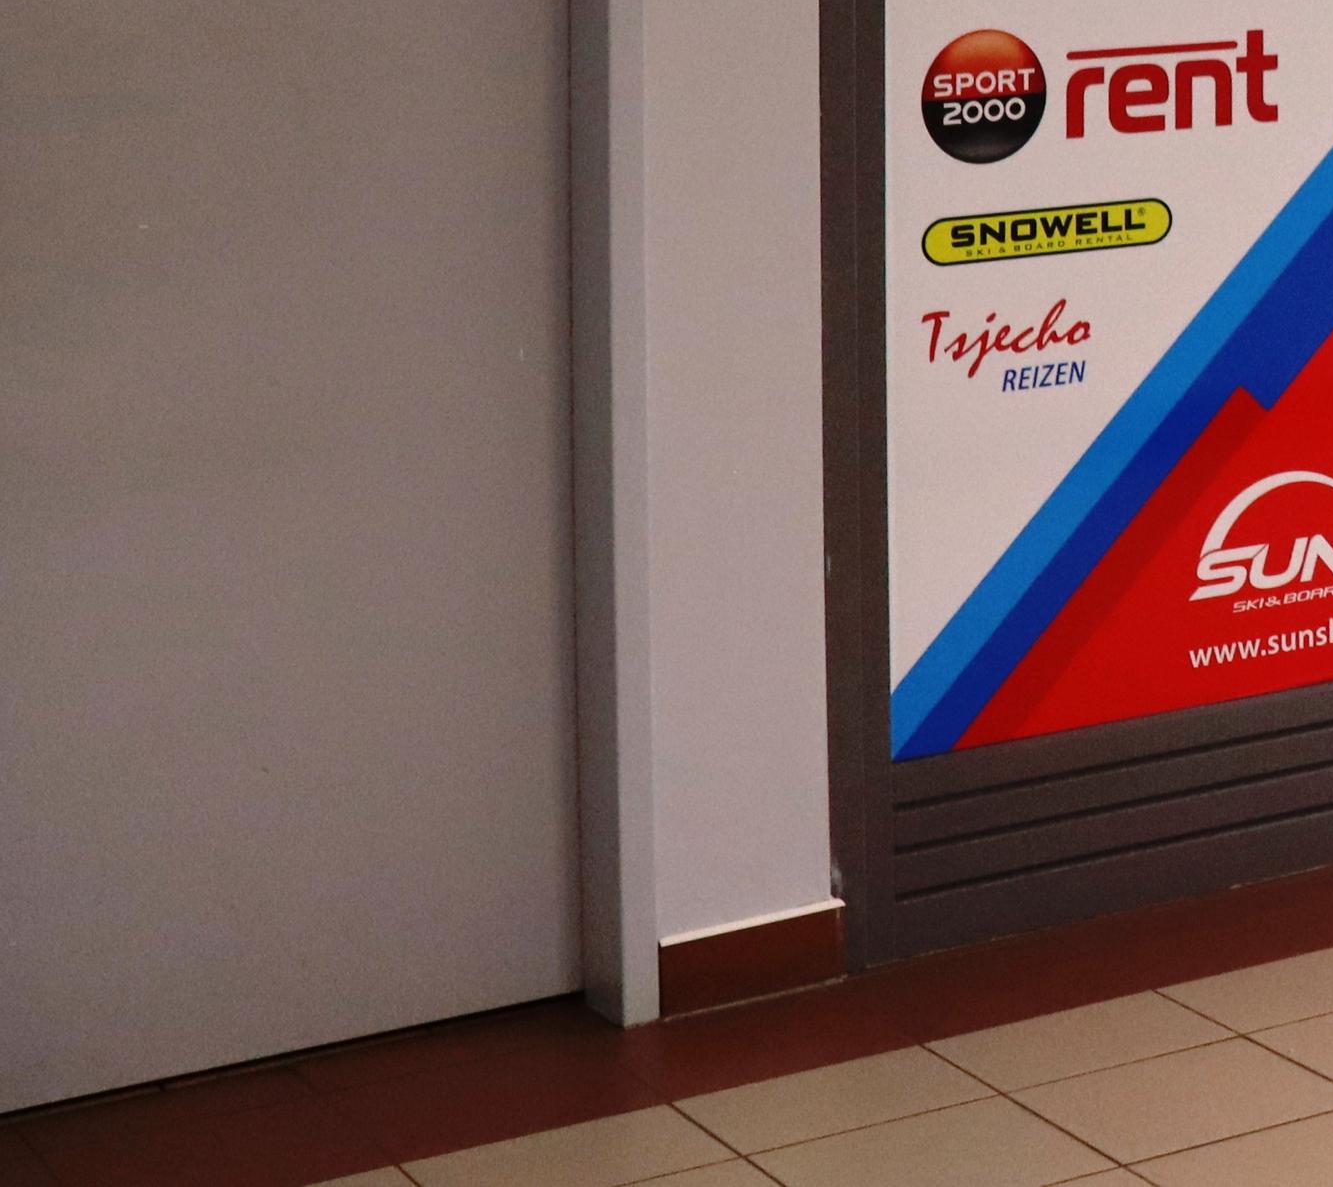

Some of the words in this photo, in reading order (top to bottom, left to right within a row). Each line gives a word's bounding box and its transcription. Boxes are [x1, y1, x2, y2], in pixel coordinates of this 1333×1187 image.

[933, 68, 1036, 98] SPORT
[1066, 29, 1279, 139] rent
[942, 98, 1026, 126] 2000
[950, 208, 1146, 248] SNOWELL
[965, 248, 991, 258] SKI
[1013, 240, 1066, 253] BOARD
[1075, 233, 1133, 246] RENTAL
[922, 298, 1091, 379] Tsjecho
[1002, 360, 1087, 392] REIZEN
